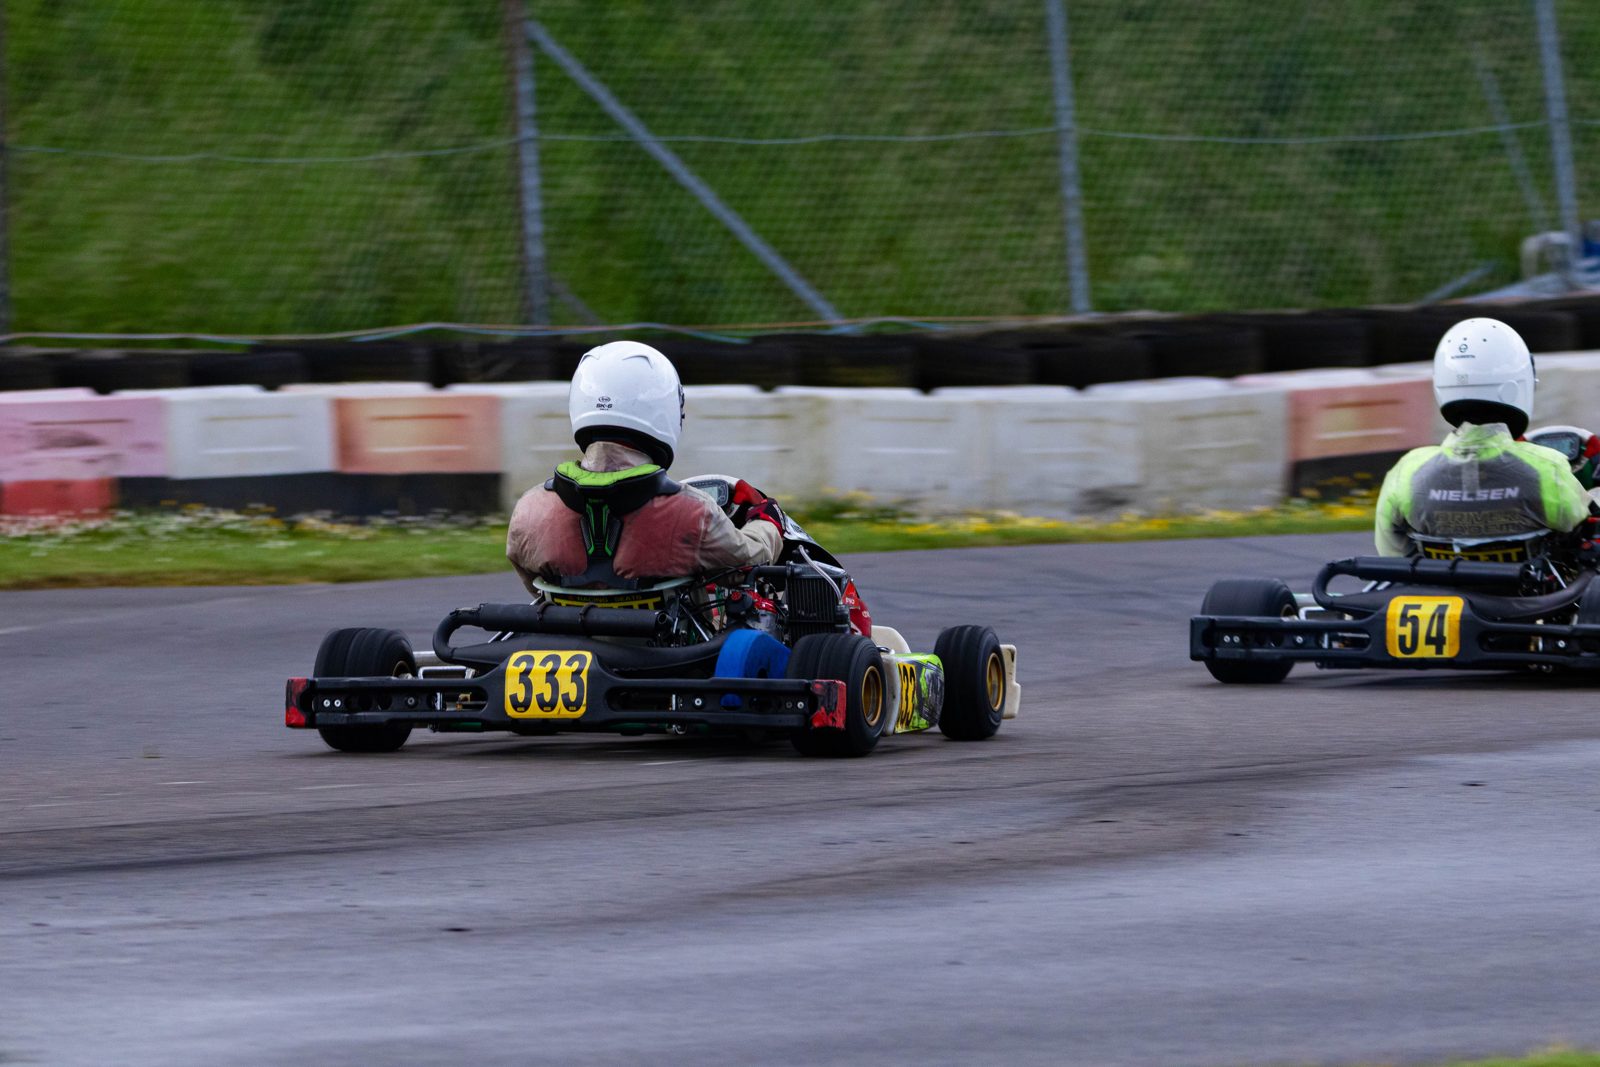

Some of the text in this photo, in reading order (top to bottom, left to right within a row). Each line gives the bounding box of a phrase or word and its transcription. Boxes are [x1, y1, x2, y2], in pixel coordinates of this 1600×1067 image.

[1429, 486, 1520, 502] NIELSEN
[1398, 603, 1450, 656] 54
[508, 653, 588, 713] 333
